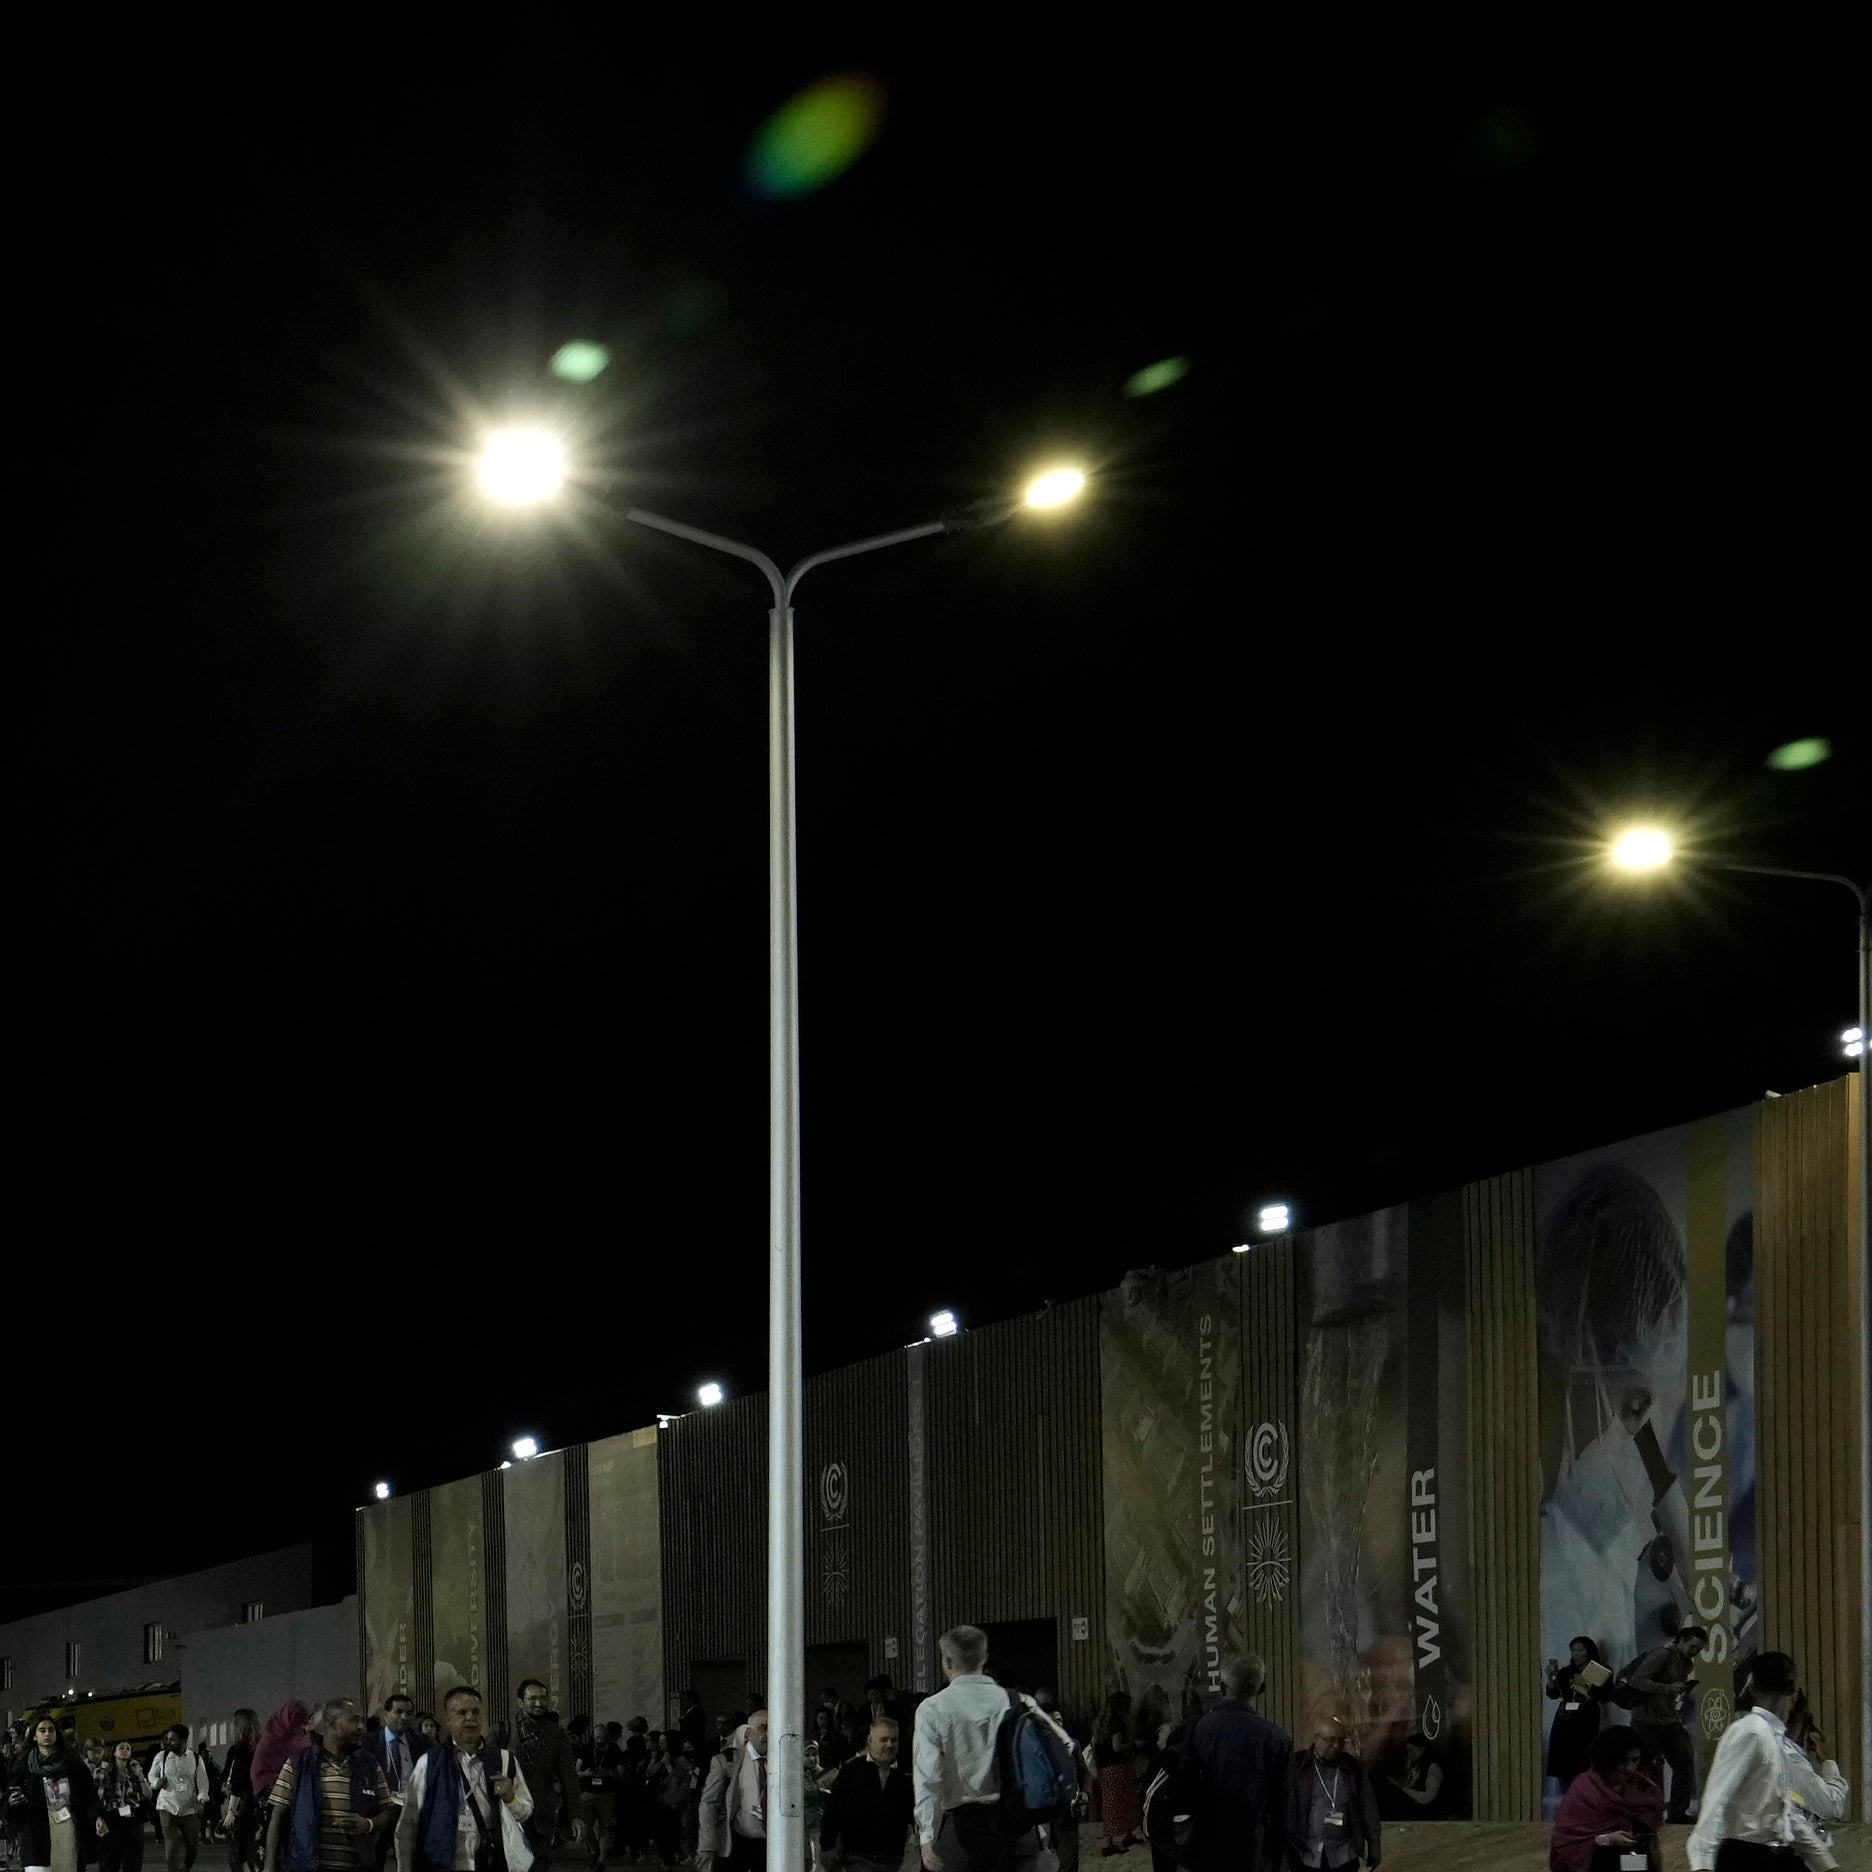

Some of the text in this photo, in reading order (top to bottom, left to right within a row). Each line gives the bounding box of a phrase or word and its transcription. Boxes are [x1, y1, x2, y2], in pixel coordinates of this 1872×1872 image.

[915, 1545, 927, 1695] ELEGATION
[1200, 1314, 1220, 1692] HUMAN SETTLEMENTS
[1411, 1467, 1441, 1669] WATER
[1692, 1369, 1728, 1665] SCIENCE
